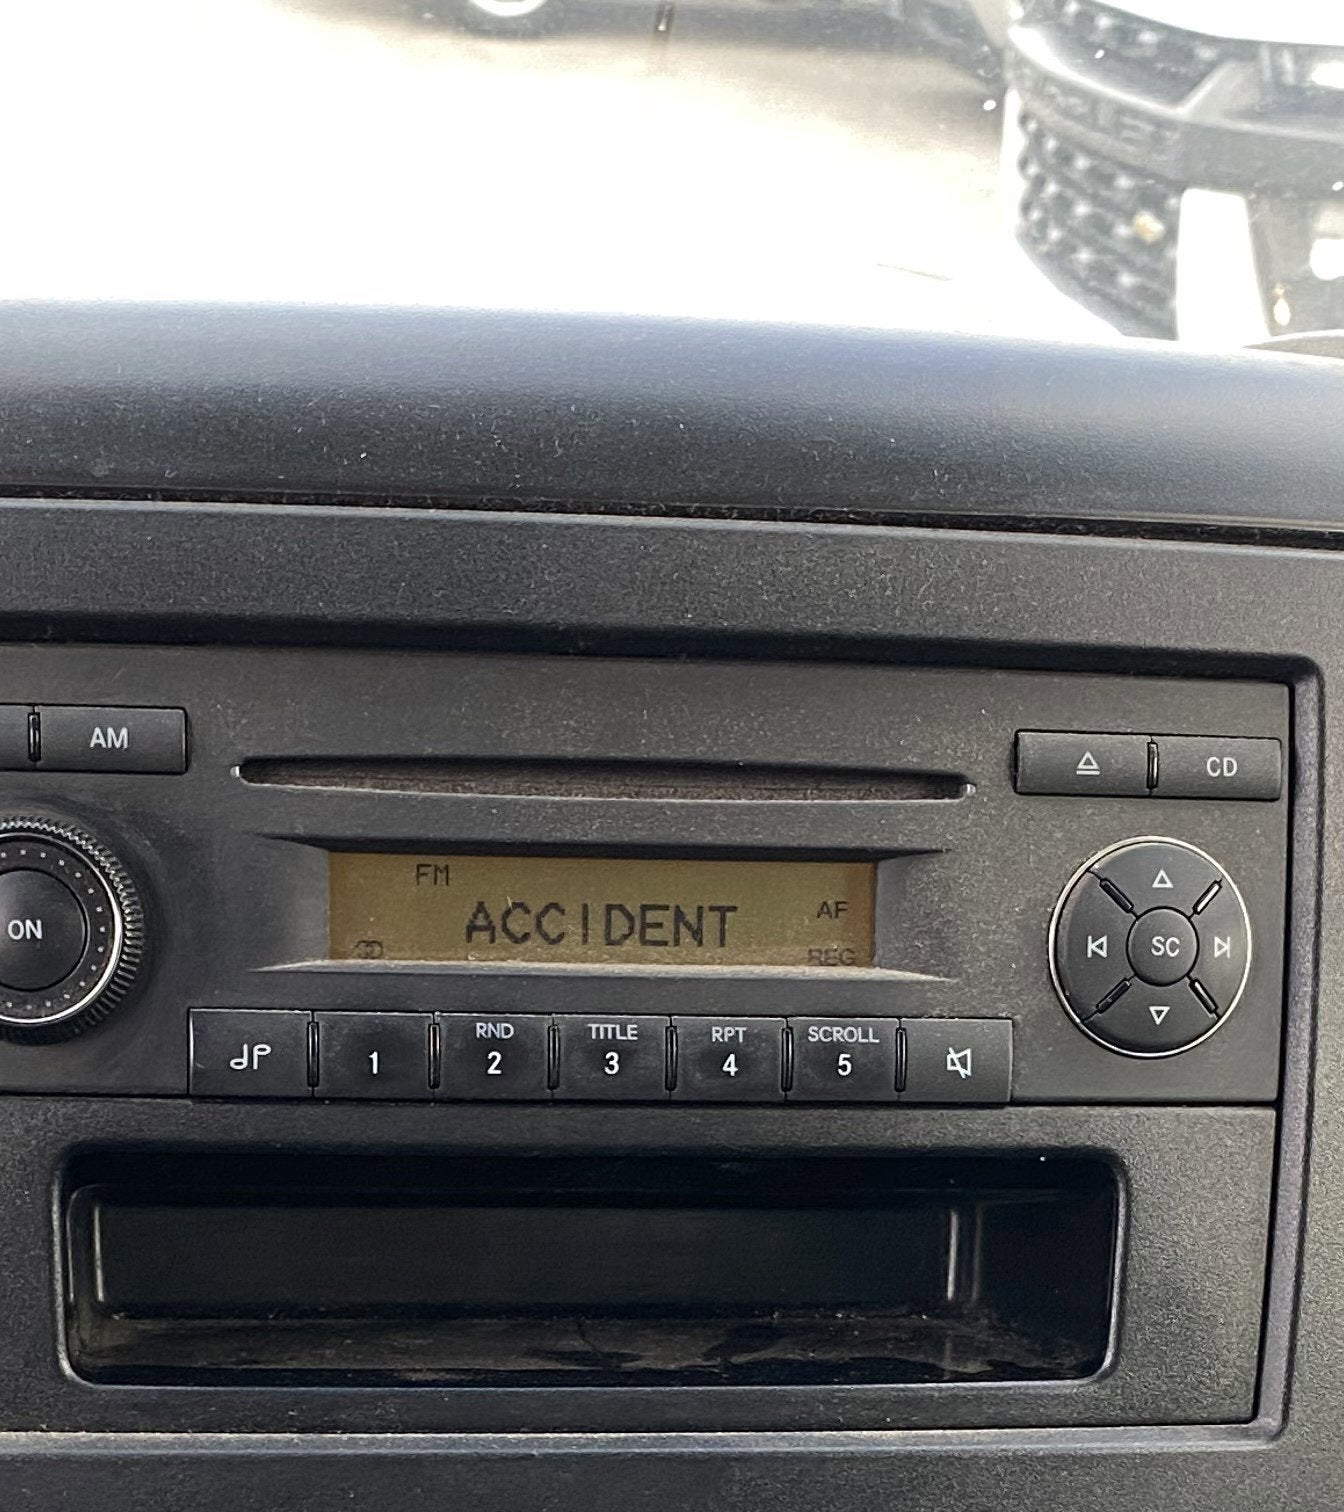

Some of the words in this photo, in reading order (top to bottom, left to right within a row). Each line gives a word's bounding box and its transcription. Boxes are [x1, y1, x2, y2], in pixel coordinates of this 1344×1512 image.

[89, 726, 128, 749] AM
[1206, 756, 1238, 777] CD
[415, 863, 450, 887] FM
[816, 900, 849, 919] AF
[6, 918, 43, 941] ON
[465, 900, 739, 948] ACCIDENT
[1150, 935, 1181, 958] SC
[475, 1022, 515, 1039] RND
[586, 1023, 639, 1041] TITLE
[711, 1026, 748, 1043] RPT
[807, 1025, 880, 1043] SCROLL
[369, 1051, 378, 1075] 1
[487, 1051, 502, 1075] 2
[604, 1051, 620, 1075] 3
[722, 1053, 739, 1077] 4
[837, 1053, 852, 1076] 5
